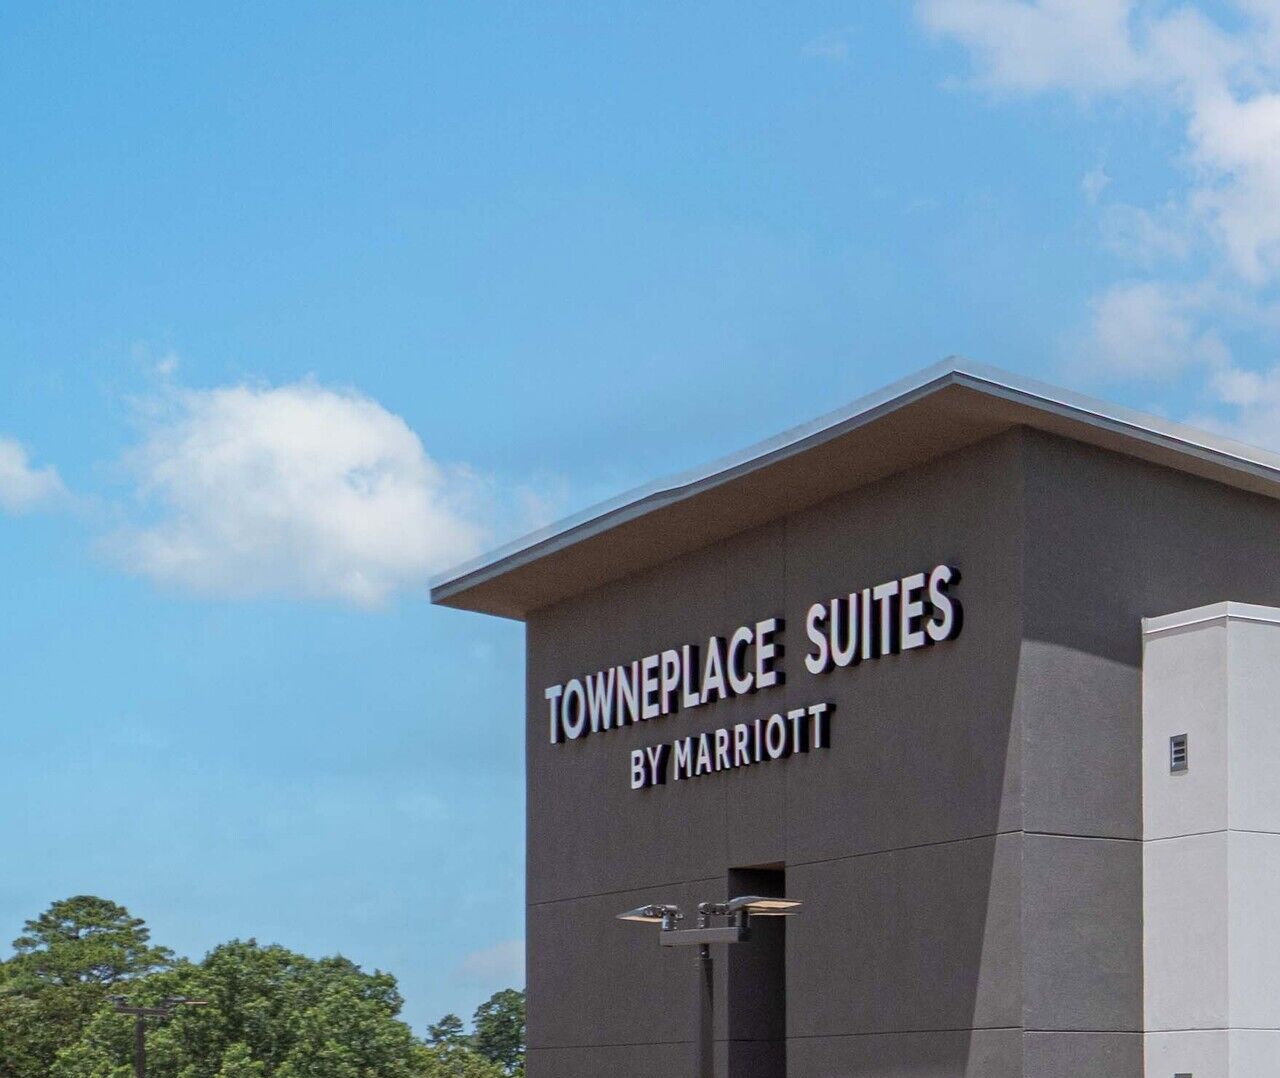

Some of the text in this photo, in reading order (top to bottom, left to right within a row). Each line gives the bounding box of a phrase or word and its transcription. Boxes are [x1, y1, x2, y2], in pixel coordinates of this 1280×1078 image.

[544, 564, 957, 744] TOWNEPLACE SUITES
[630, 702, 831, 790] BY MARRIOTT
